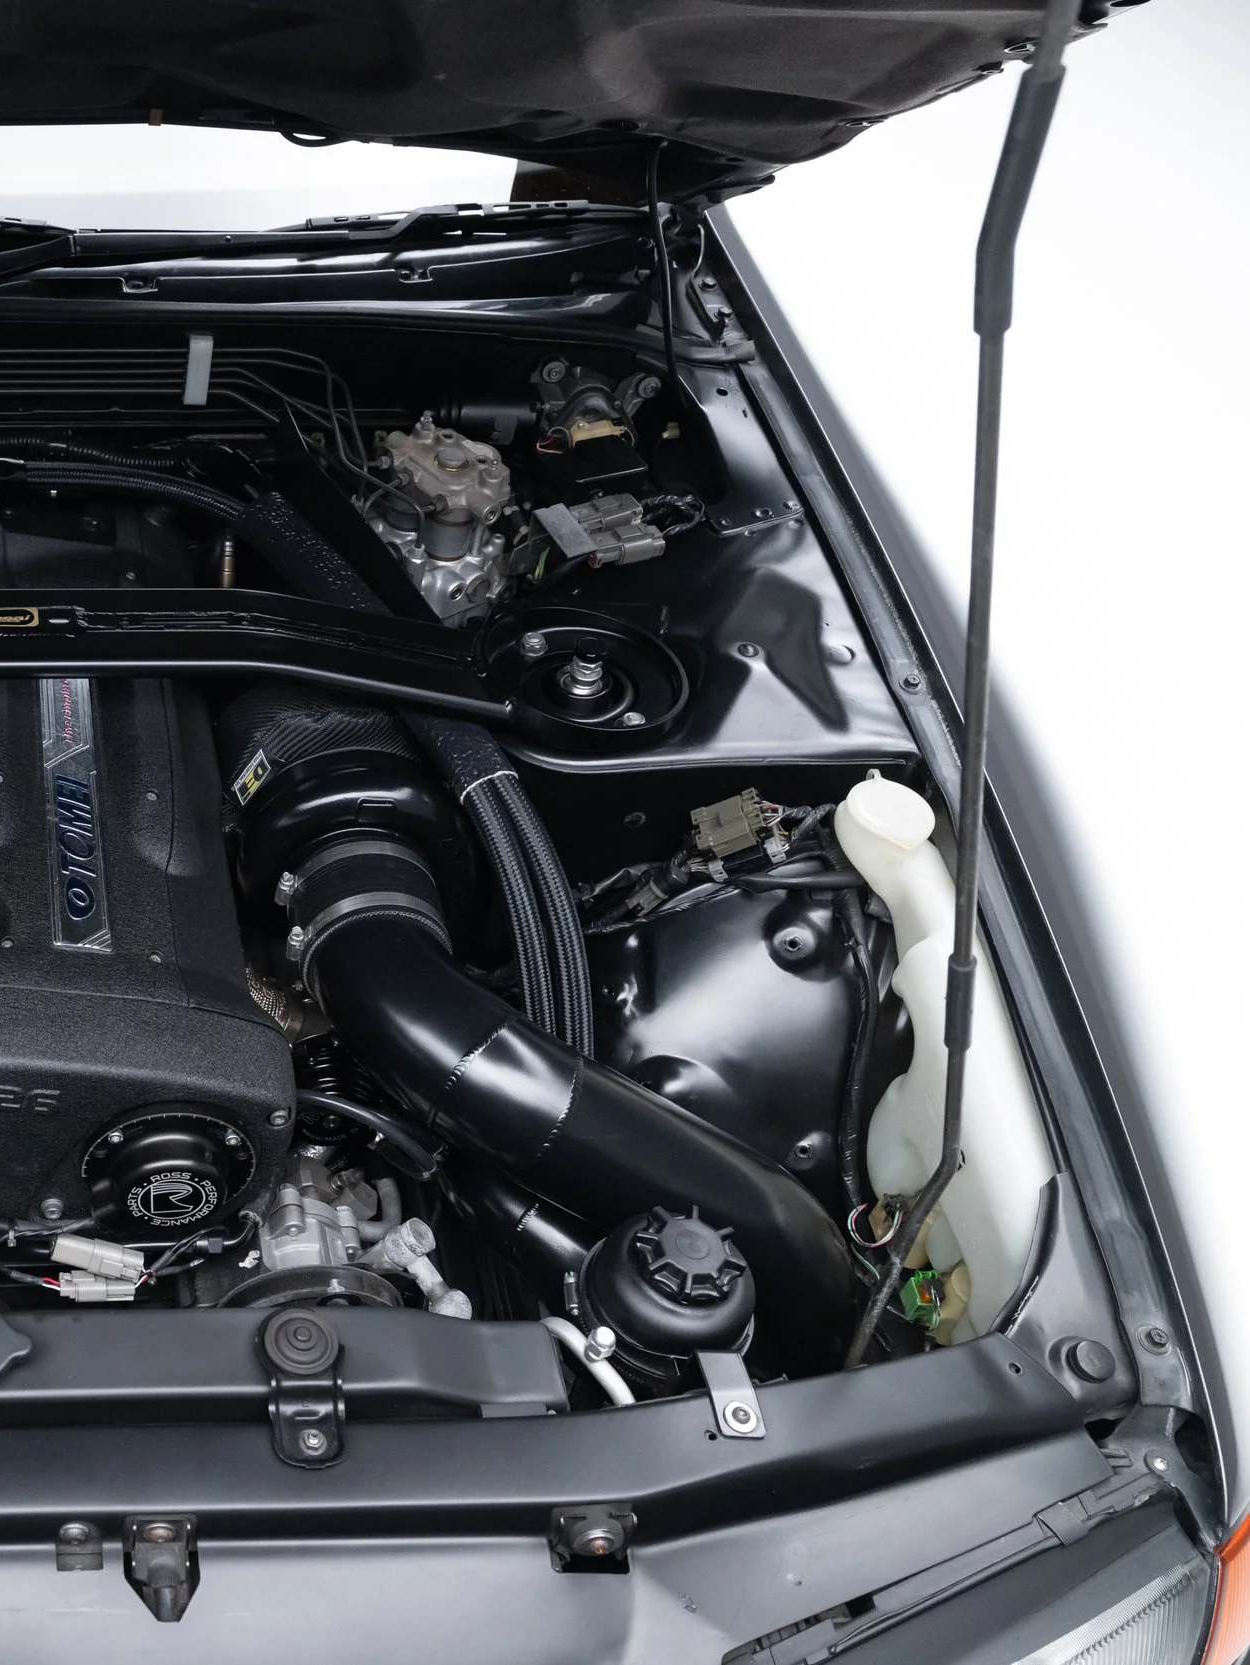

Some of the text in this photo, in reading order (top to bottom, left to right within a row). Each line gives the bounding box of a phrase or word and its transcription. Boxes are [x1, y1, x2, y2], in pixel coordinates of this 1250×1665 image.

[150, 1172, 192, 1183] ROSS
[127, 1186, 144, 1218] PARTS
[150, 1180, 218, 1227] PERFORMANCE
